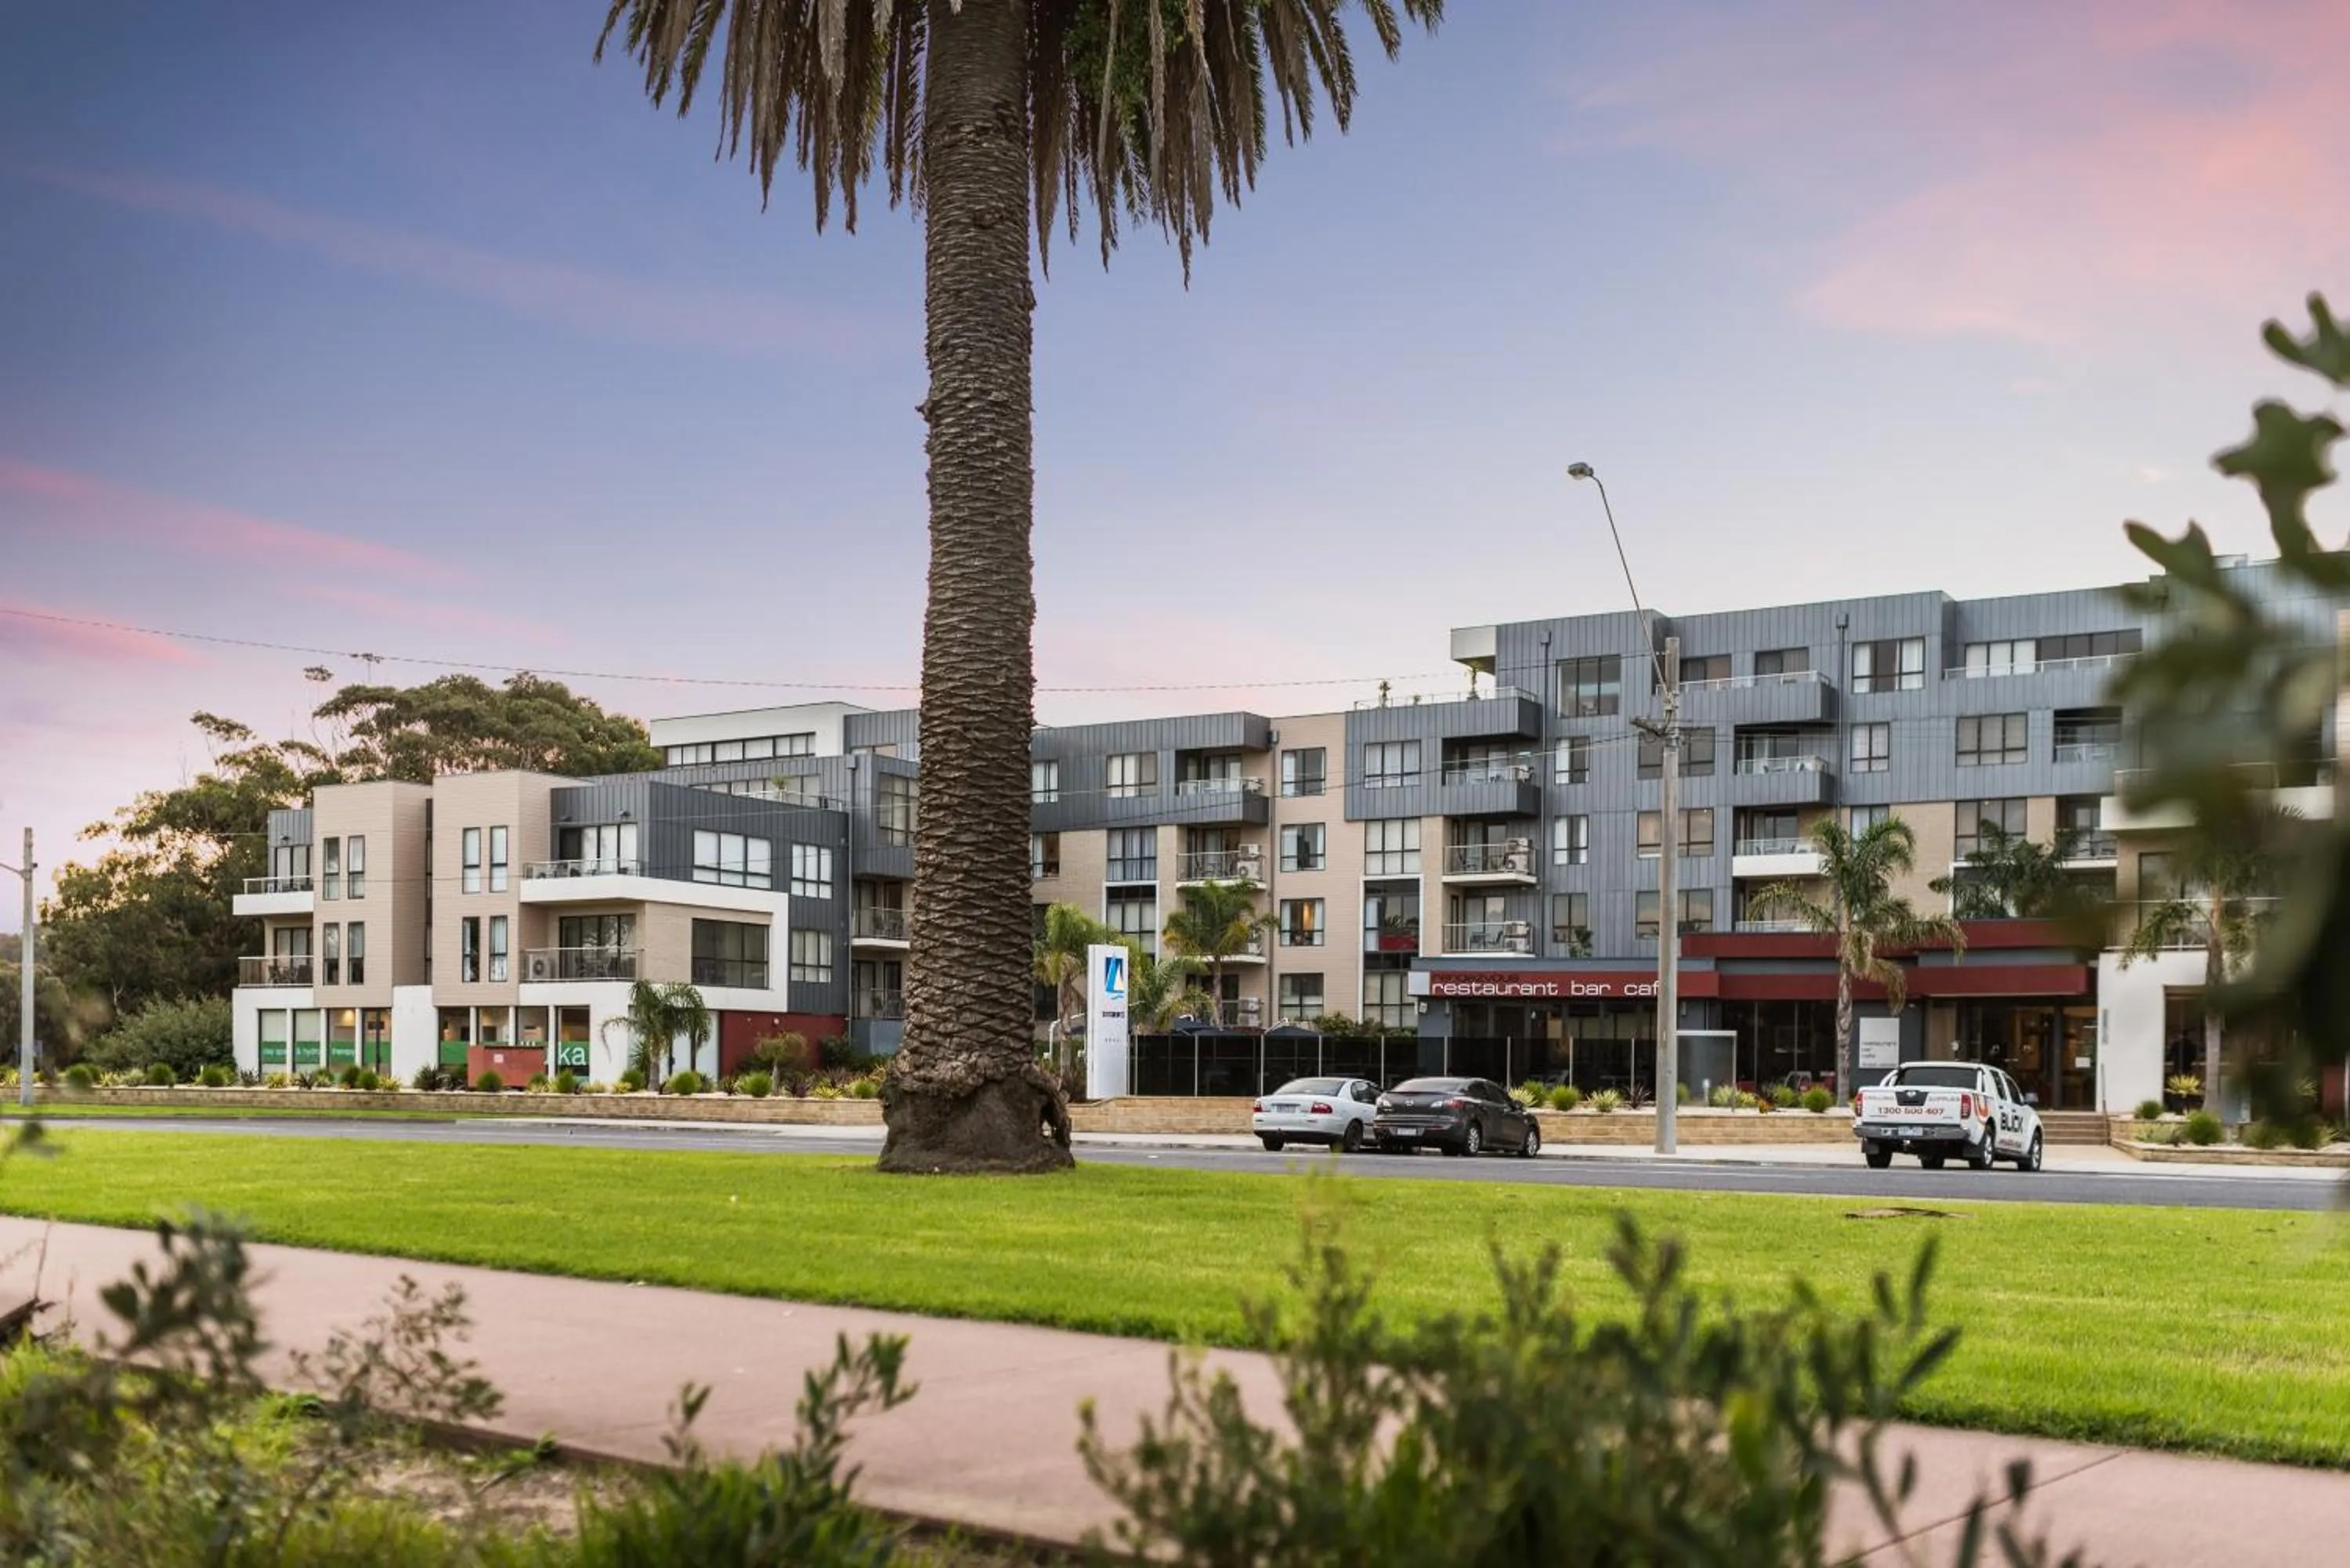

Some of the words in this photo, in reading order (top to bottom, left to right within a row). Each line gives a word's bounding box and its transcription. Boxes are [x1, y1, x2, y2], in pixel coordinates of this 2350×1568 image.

[1432, 981, 1558, 995] restaurant
[1571, 981, 1611, 995] bar
[1624, 980, 1660, 995] caf
[544, 1041, 587, 1066] ka
